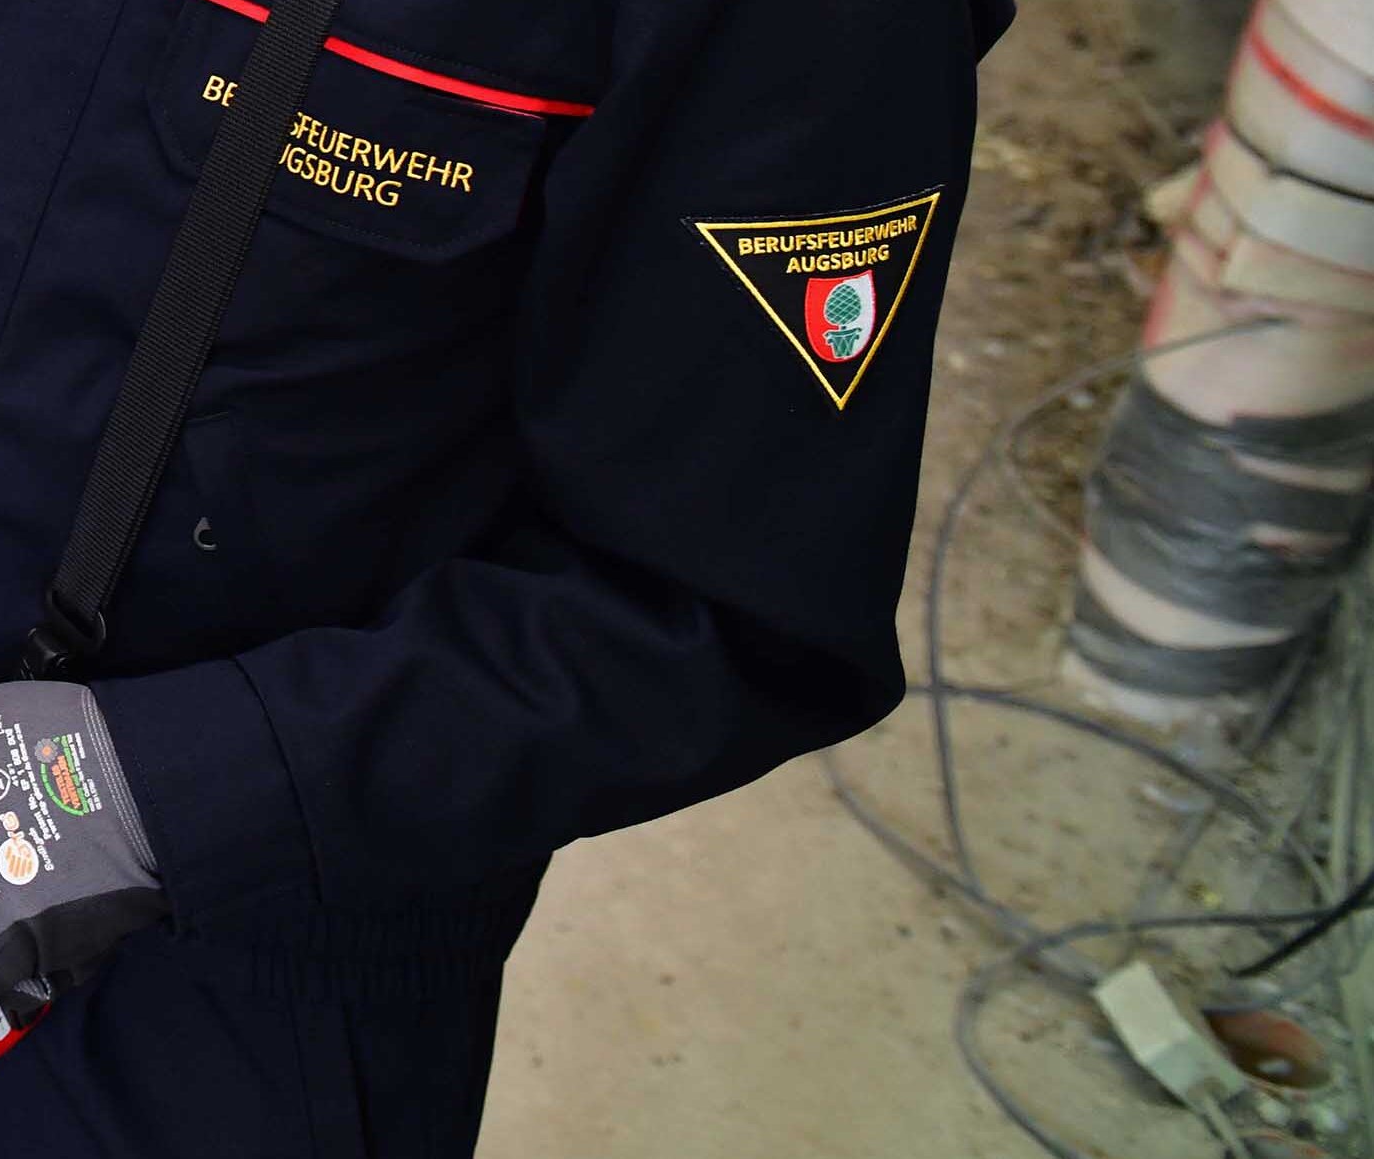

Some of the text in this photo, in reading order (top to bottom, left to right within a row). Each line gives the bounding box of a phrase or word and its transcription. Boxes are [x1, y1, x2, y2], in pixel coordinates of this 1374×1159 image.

[202, 75, 474, 192] BEFEUERWEHR
[279, 143, 402, 206] GSBURG
[738, 215, 917, 256] BERUFSFEUERWEHR
[786, 244, 890, 274] AUGSBURG
